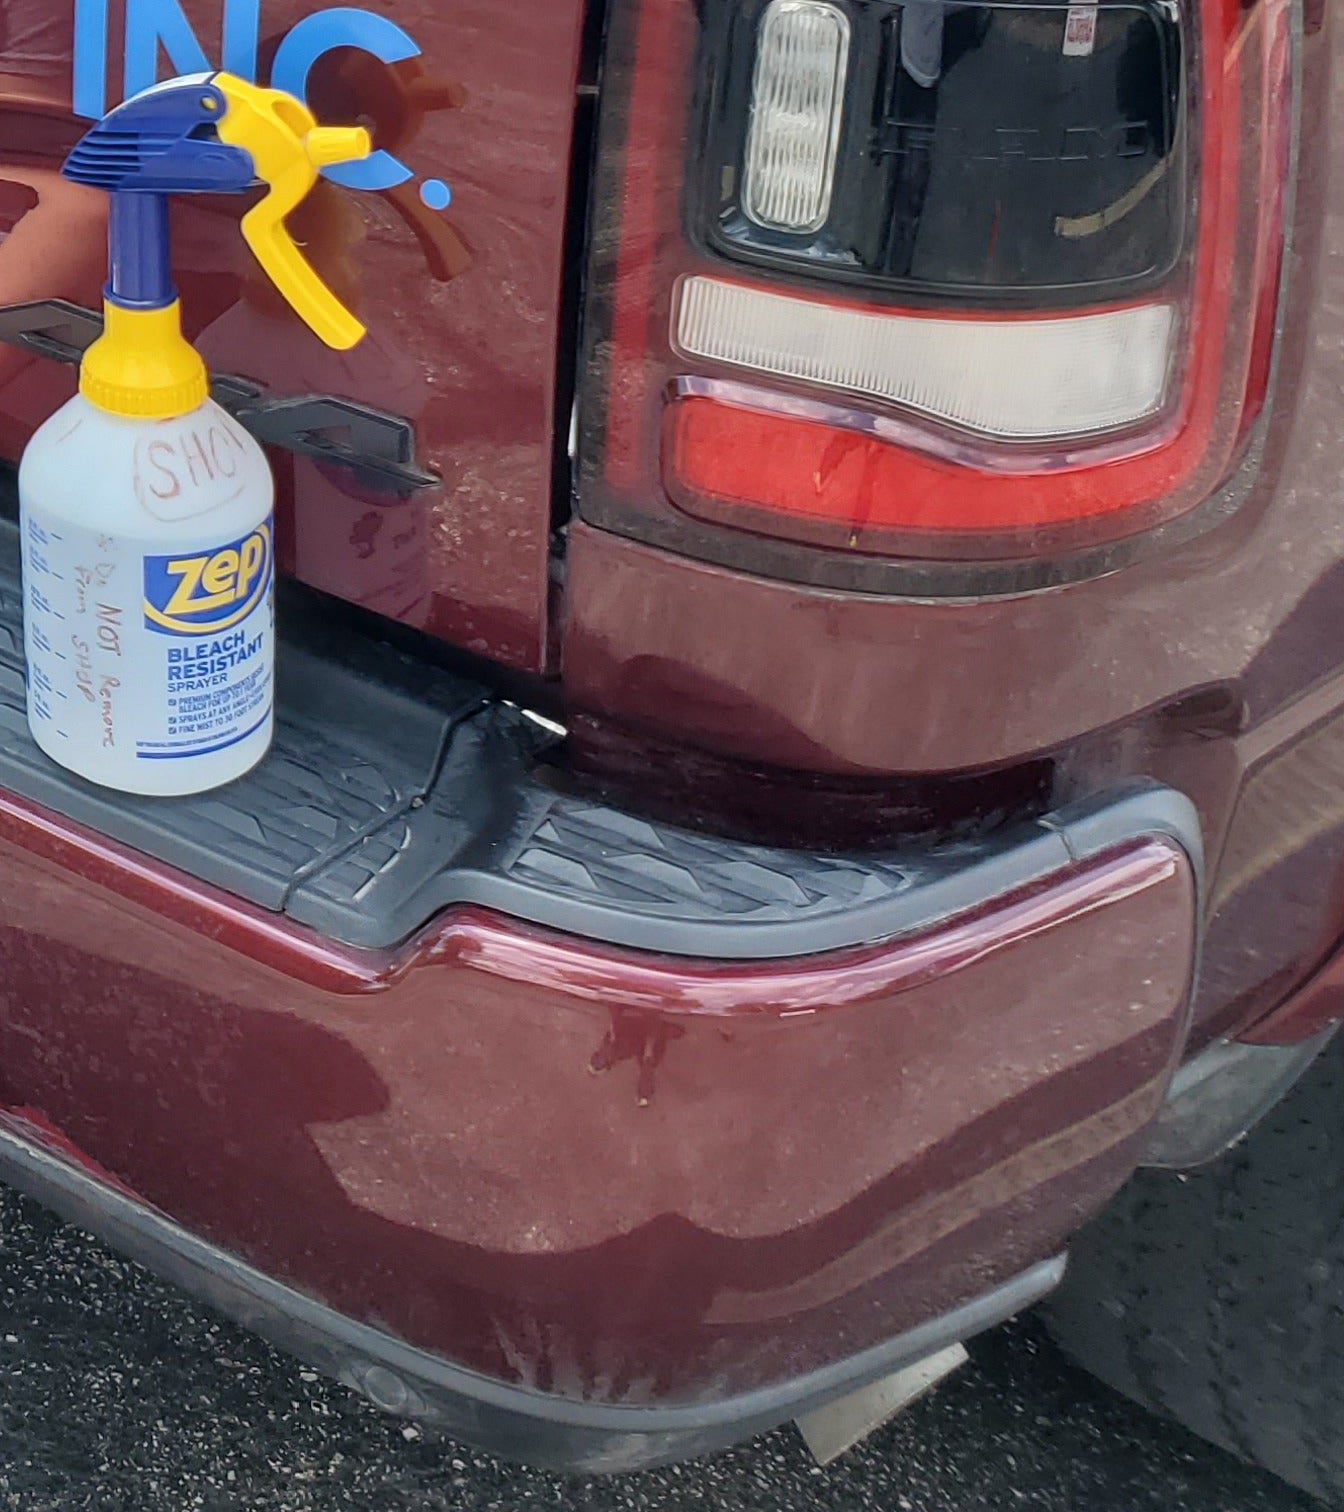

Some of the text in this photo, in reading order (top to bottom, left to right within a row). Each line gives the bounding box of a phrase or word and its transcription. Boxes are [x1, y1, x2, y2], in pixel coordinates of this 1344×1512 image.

[95, 601, 123, 657] NOT
[167, 629, 245, 664] BLEACH
[167, 631, 264, 681] RESISTANT
[167, 672, 229, 693] SPRAYER
[178, 713, 207, 724] SPRAYS
[208, 708, 217, 718] AT
[218, 704, 231, 715] ANY
[215, 717, 224, 727] TO
